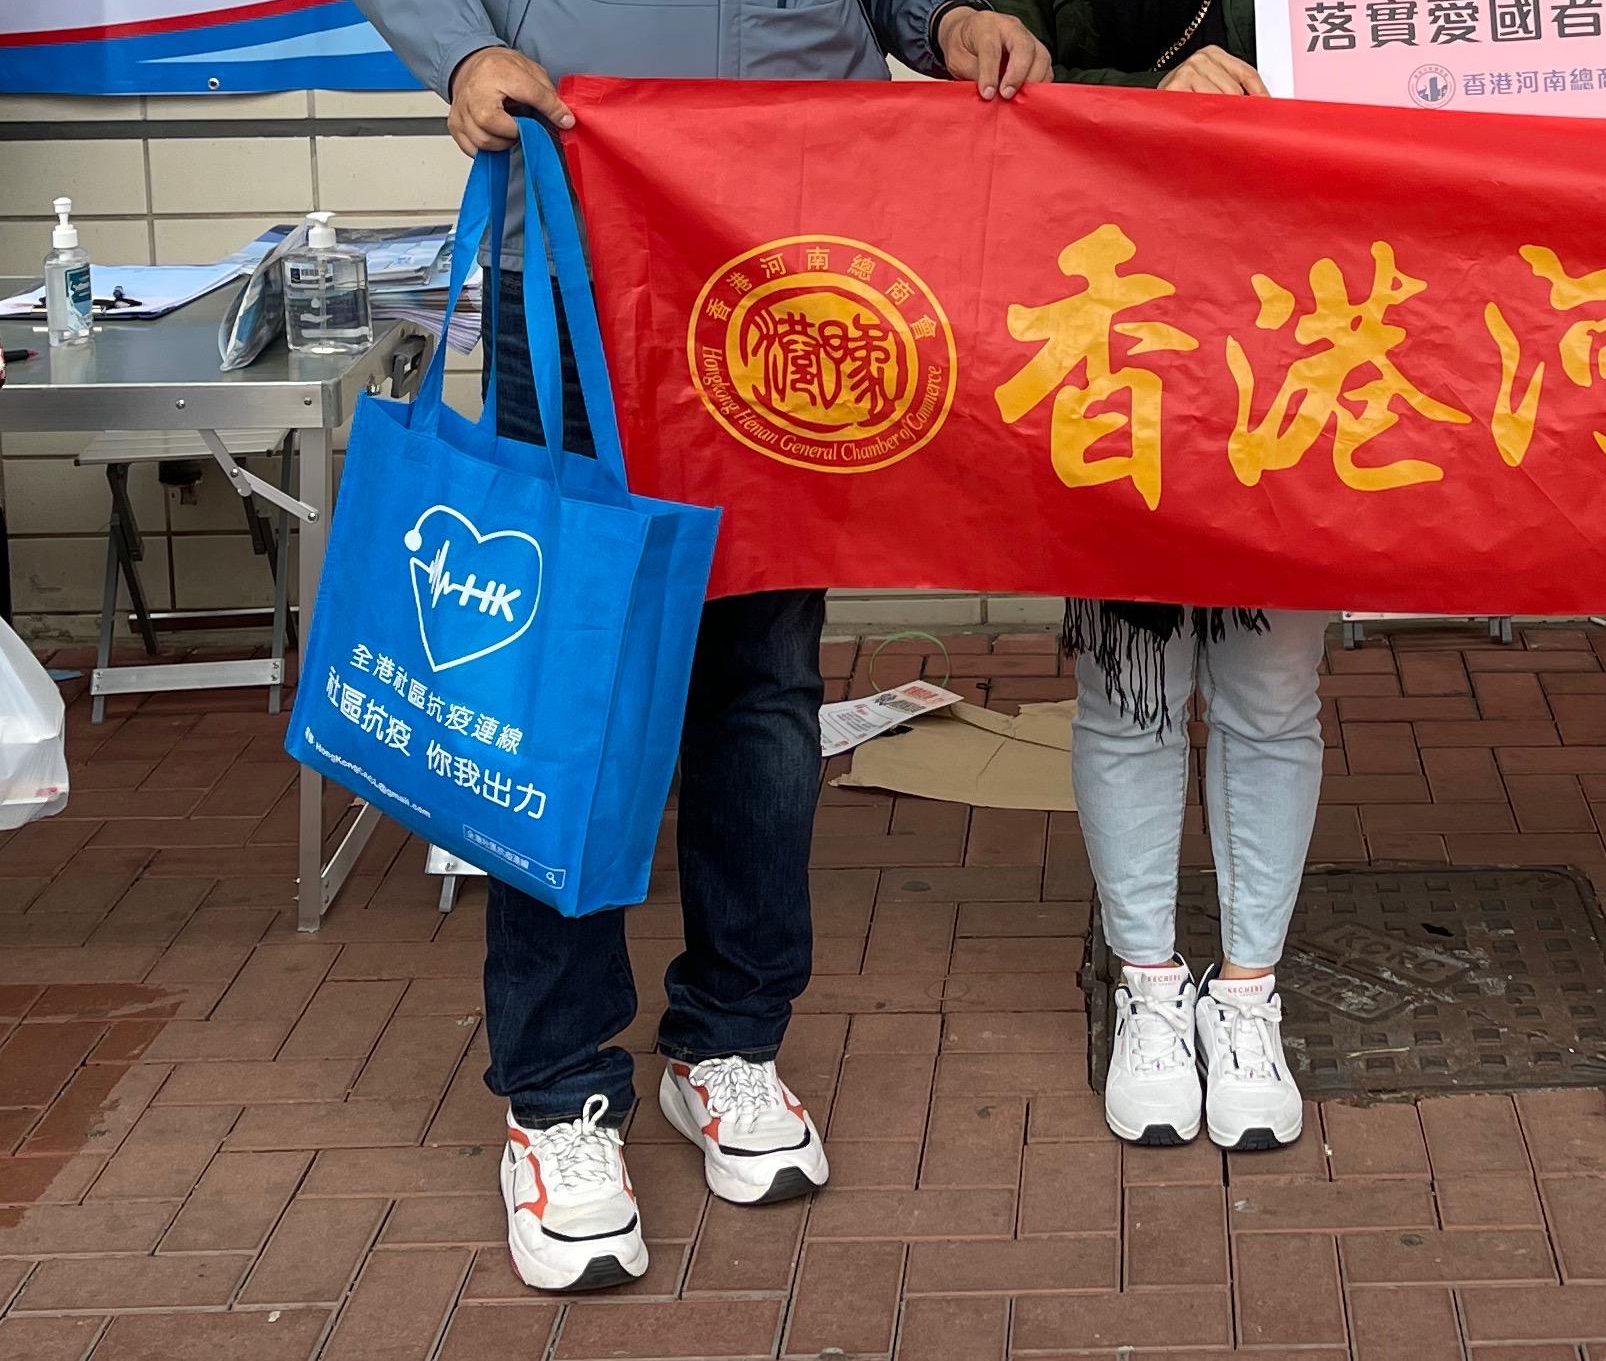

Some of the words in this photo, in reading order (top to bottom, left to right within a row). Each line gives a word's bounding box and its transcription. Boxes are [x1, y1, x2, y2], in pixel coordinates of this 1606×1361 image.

[705, 246, 938, 340] 香港河南總商會
[702, 346, 739, 415] Hongkong
[906, 365, 942, 430] Commerce
[733, 408, 779, 444] Henan
[780, 434, 837, 460] General
[841, 437, 899, 461] Chamber
[900, 418, 917, 441] of
[350, 643, 523, 755] 全港社區抗疫連線
[326, 666, 411, 757] 社區抗疫
[426, 739, 547, 820] 你我出力
